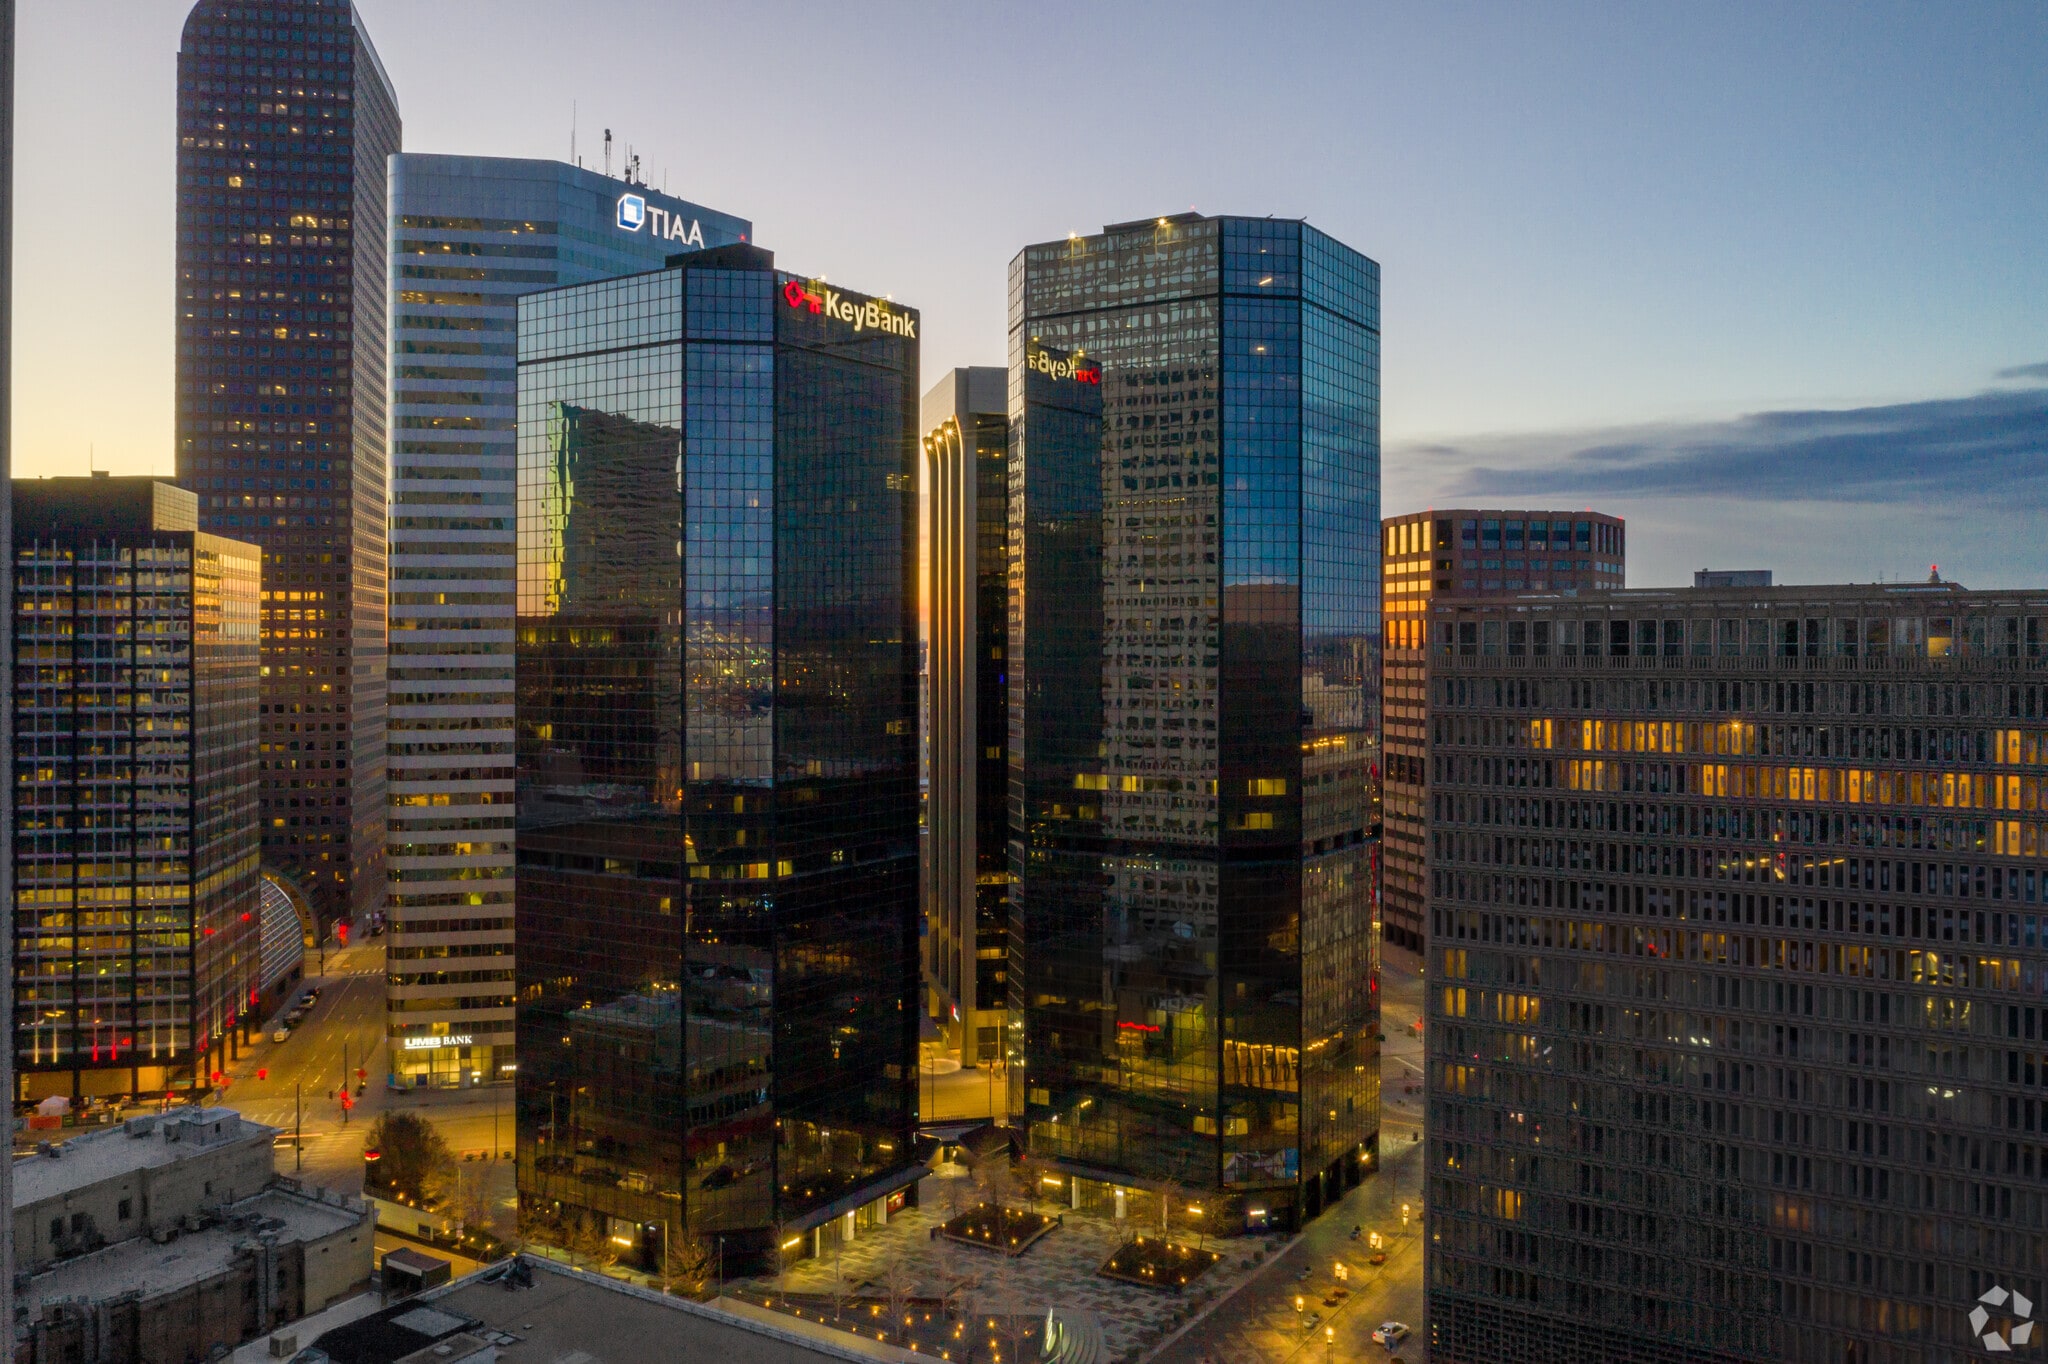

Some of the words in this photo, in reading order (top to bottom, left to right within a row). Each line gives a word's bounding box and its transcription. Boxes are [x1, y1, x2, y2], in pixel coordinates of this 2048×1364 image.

[646, 205, 705, 249] TIAA
[826, 290, 916, 339] KeyBank
[404, 1036, 441, 1048] UMB
[443, 1035, 473, 1046] BANK
